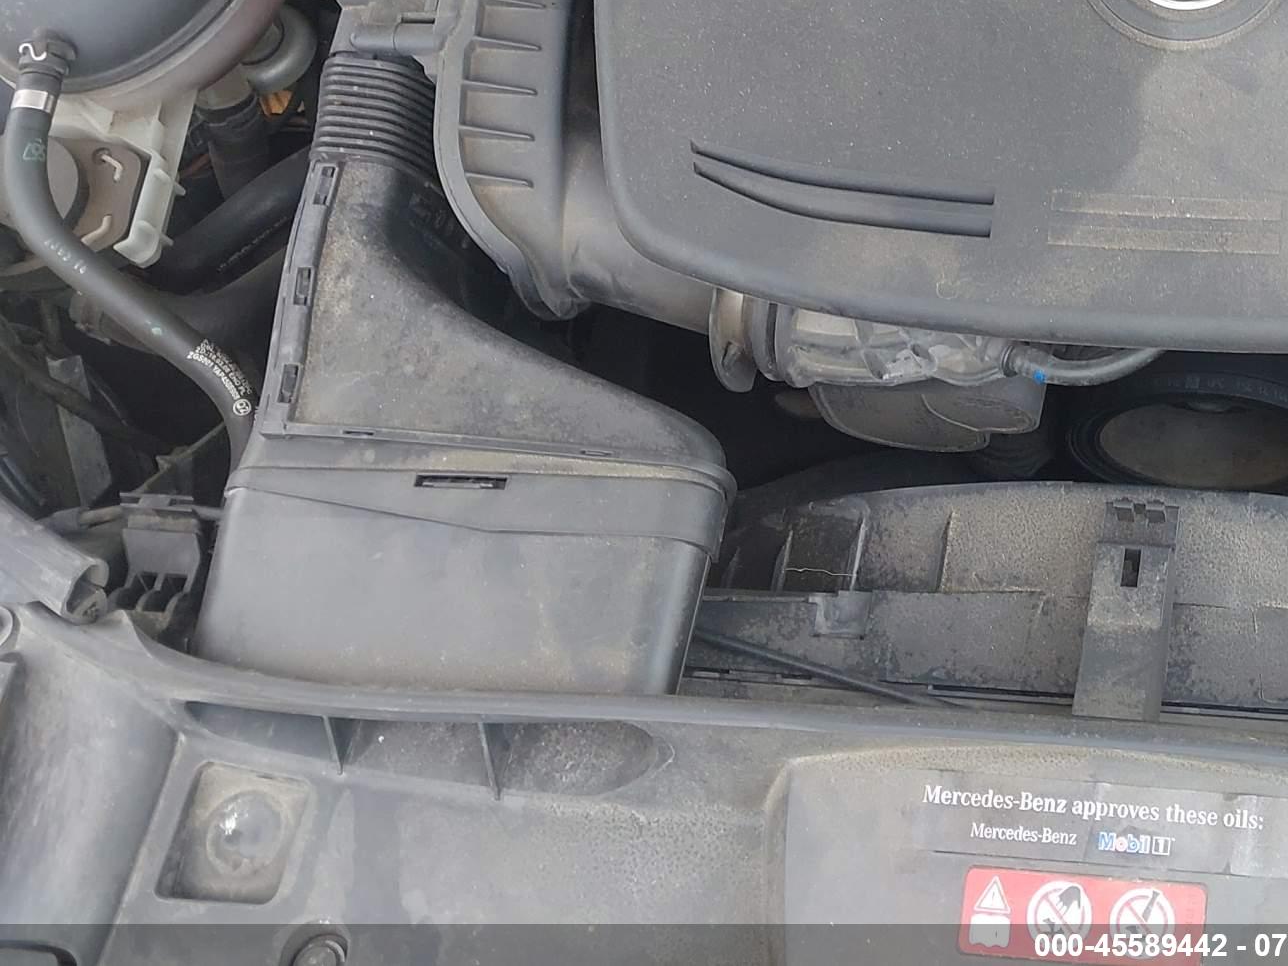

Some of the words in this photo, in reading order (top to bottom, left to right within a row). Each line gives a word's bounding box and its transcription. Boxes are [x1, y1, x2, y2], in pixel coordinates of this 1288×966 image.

[922, 785, 1067, 814] Mercedes-Benz
[1072, 799, 1160, 821] approves
[1166, 803, 1218, 827] these
[1223, 808, 1264, 830] oils:
[970, 822, 1078, 846] Mercedes-Benz
[1098, 831, 1151, 854] Mobil
